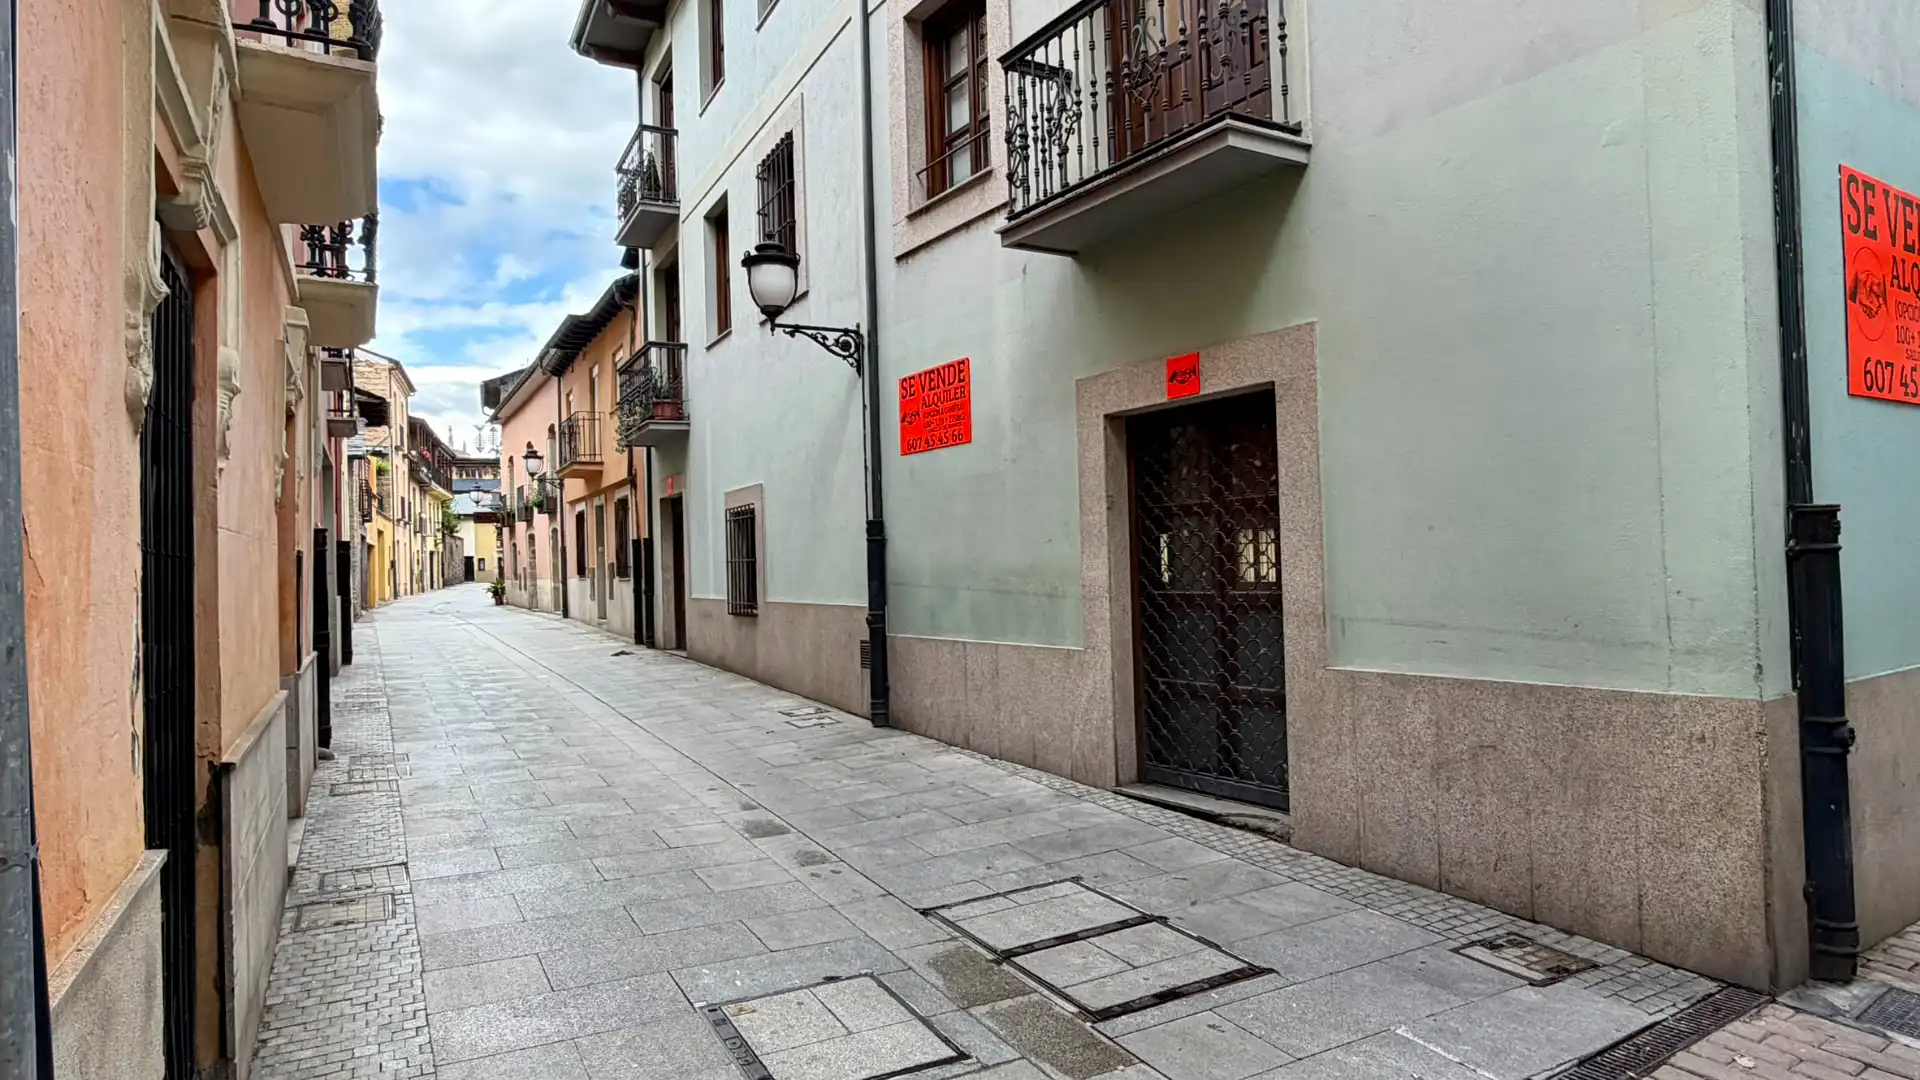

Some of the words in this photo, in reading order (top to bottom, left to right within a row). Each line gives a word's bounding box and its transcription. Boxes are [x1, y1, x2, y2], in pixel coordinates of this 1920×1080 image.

[1847, 174, 1878, 241] SE
[901, 376, 916, 400] SE
[919, 360, 965, 393] VENDE
[921, 386, 966, 409] ALQUILER
[1864, 357, 1894, 394] 607
[1900, 364, 1918, 399] 45
[907, 437, 922, 452] 607
[925, 433, 935, 448] 45
[938, 430, 949, 445] 45
[952, 428, 964, 442] 66
